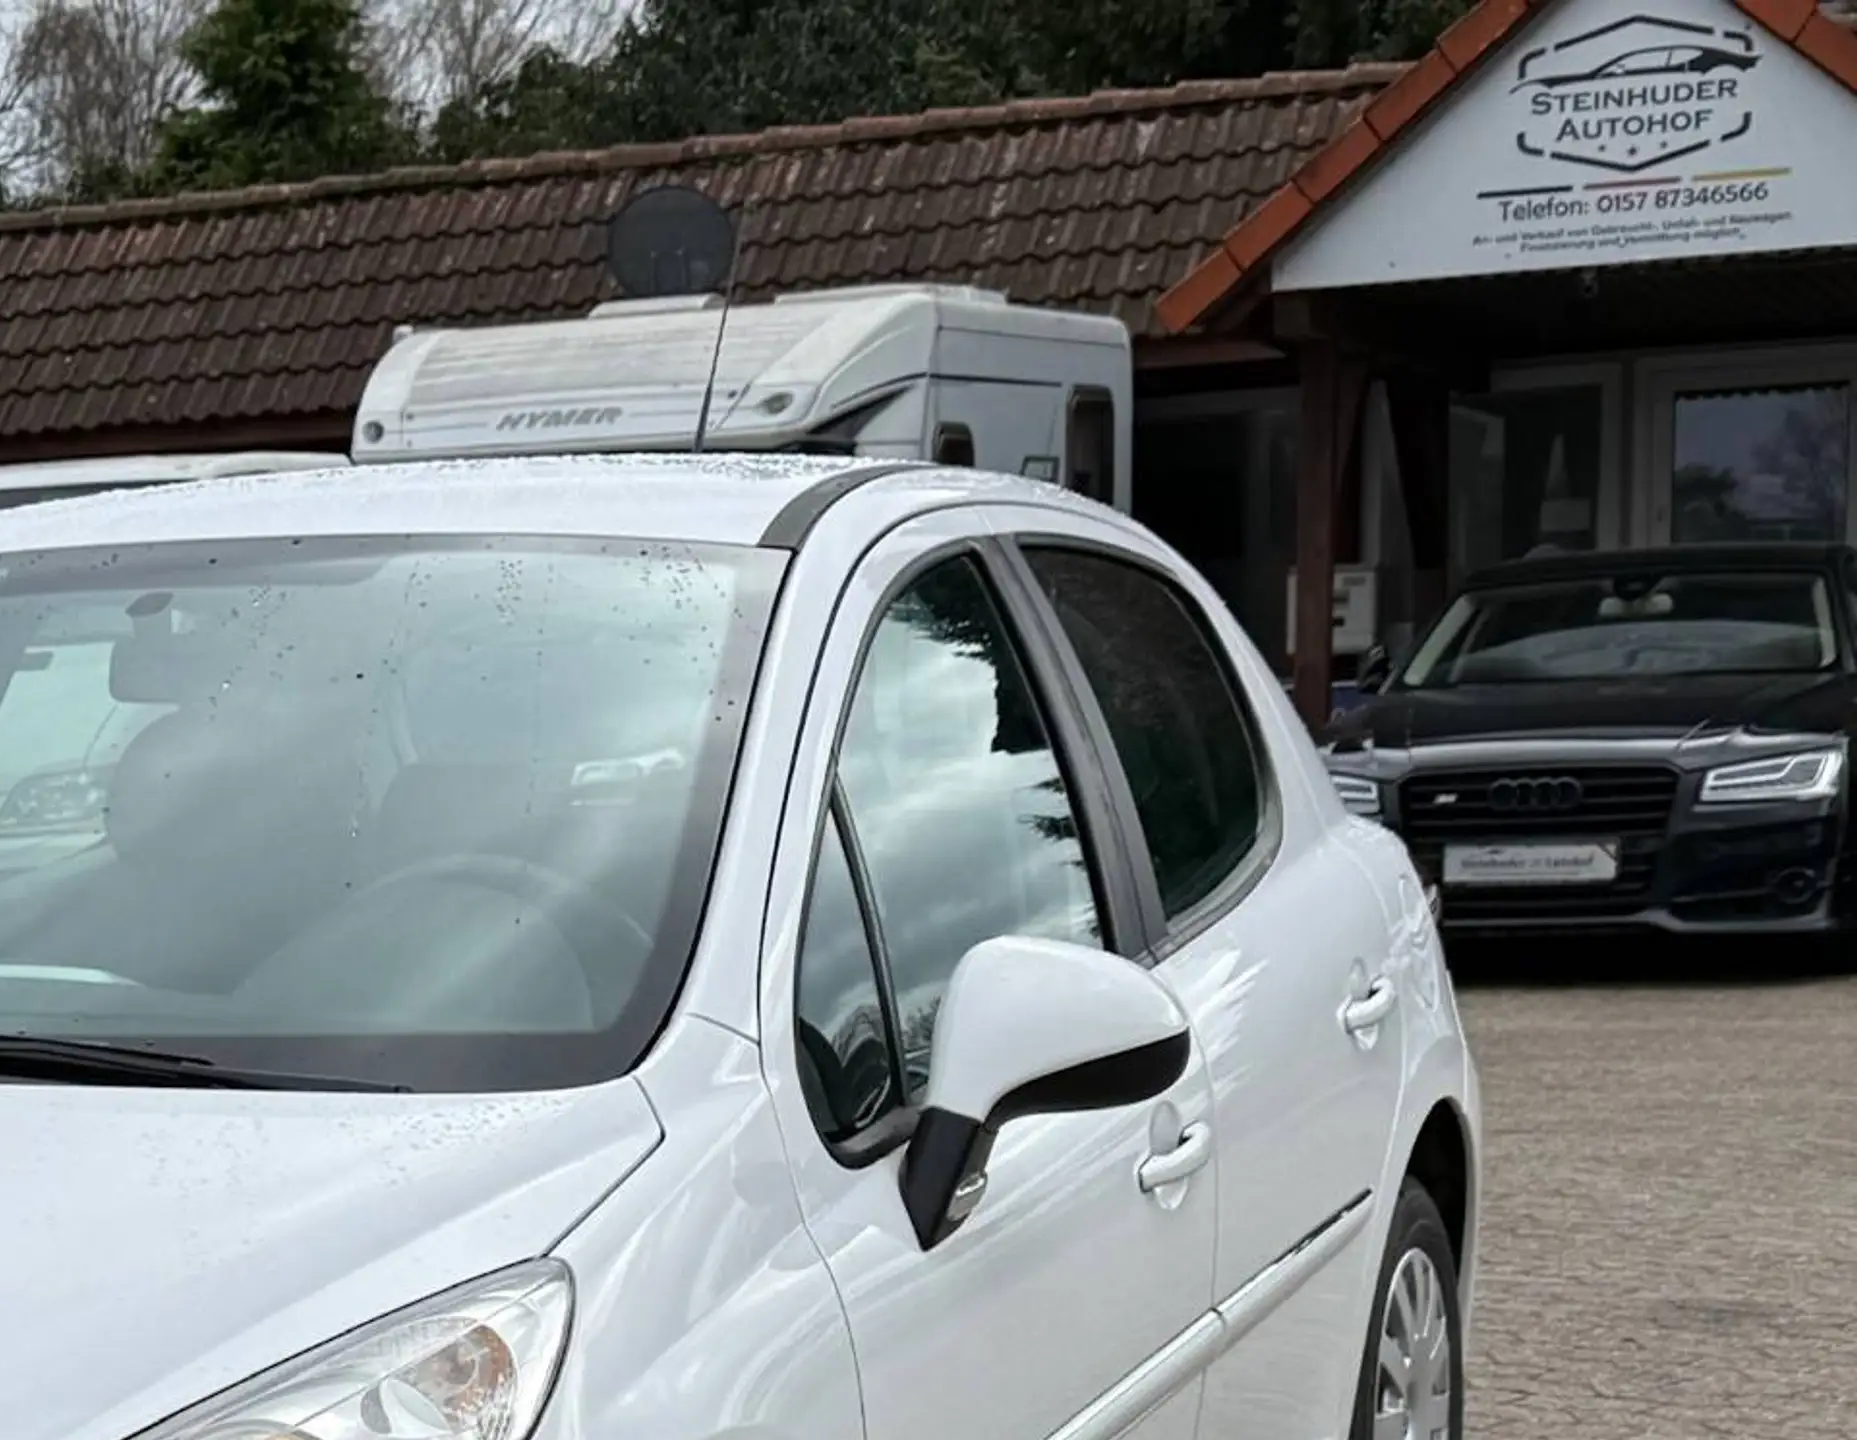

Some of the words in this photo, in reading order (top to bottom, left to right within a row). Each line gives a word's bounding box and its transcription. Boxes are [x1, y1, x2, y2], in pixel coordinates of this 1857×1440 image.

[1531, 78, 1738, 115] STEINHUDER
[1555, 109, 1713, 142] AUTOHOF
[1498, 198, 1590, 222] Telefon:
[1597, 192, 1649, 214] 0157
[1655, 181, 1770, 209] 87346566
[496, 406, 622, 431] HYMER
